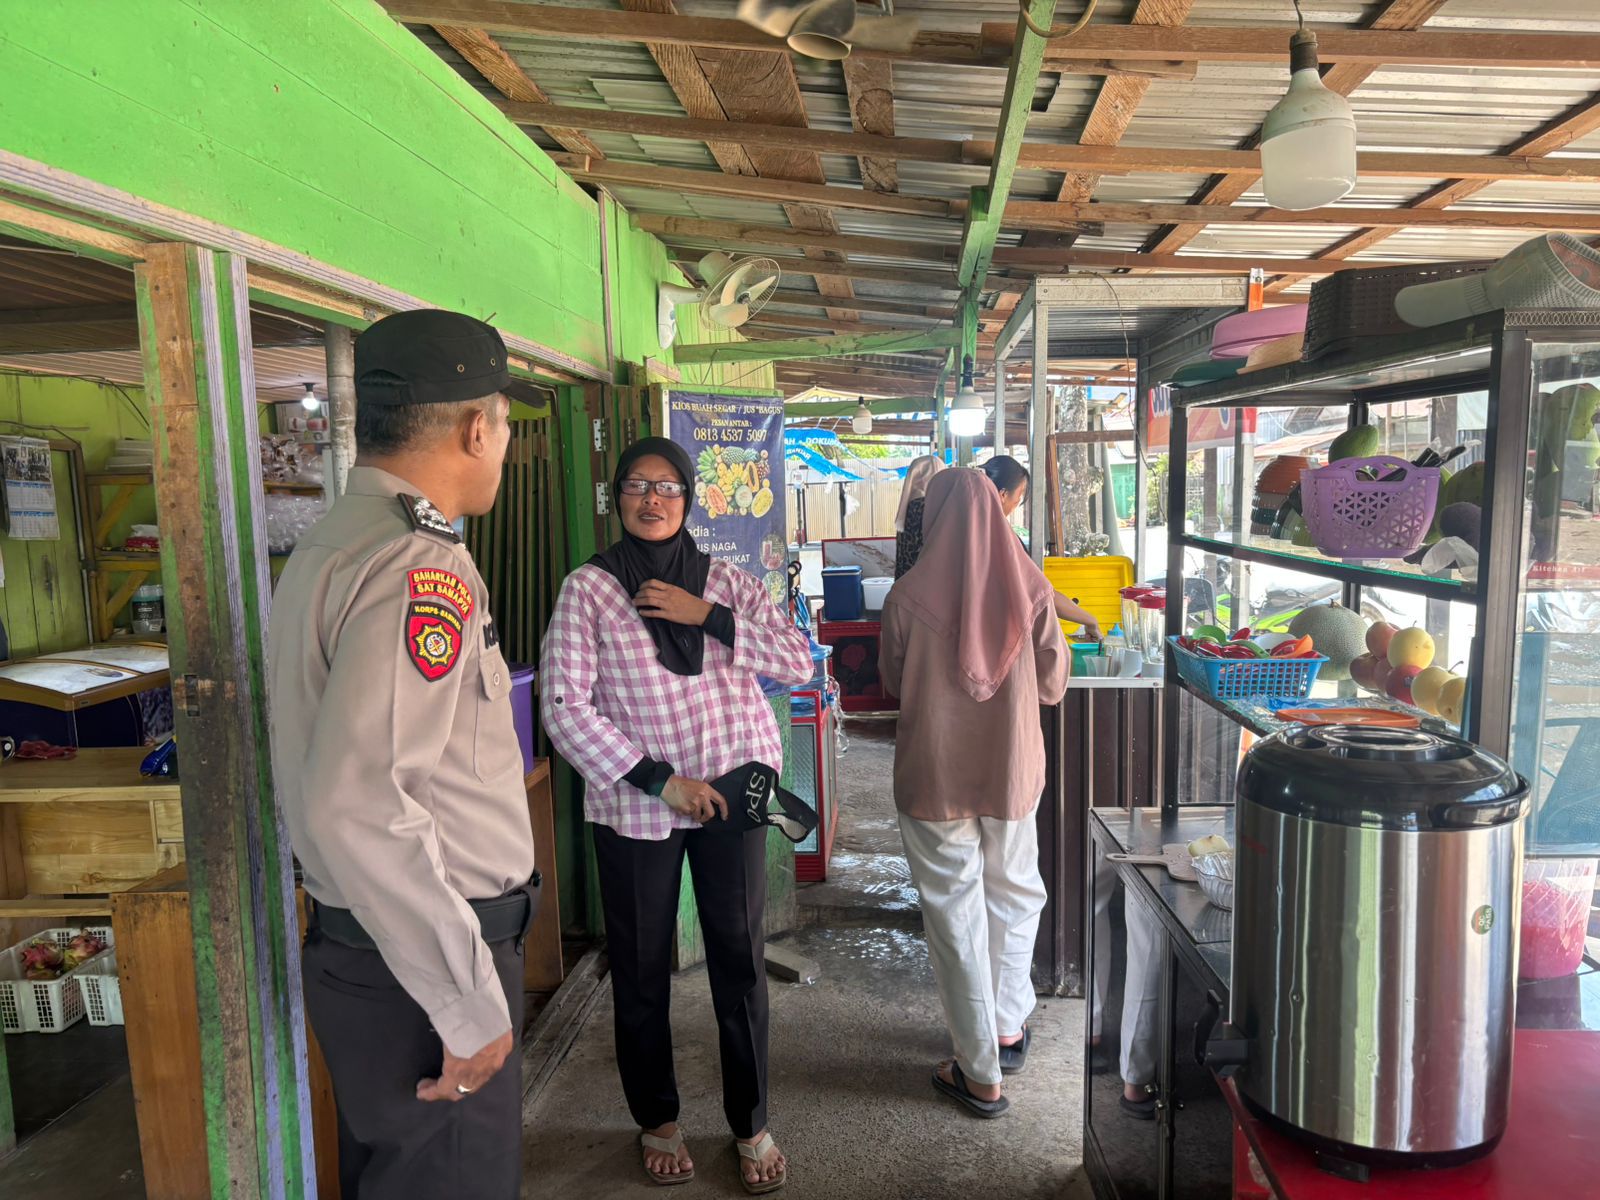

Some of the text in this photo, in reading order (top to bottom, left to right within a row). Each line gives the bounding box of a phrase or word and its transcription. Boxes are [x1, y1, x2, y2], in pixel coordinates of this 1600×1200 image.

[672, 401, 691, 411] KIOS
[691, 403, 712, 412] BUAH
[713, 404, 736, 413] SEGAR
[743, 405, 755, 415] JUS
[694, 427, 768, 442] 0813 4537 5097
[687, 525, 709, 537] edia
[696, 542, 737, 552] US NAGA
[720, 554, 751, 564] PUKAT
[417, 583, 435, 594] SAT
